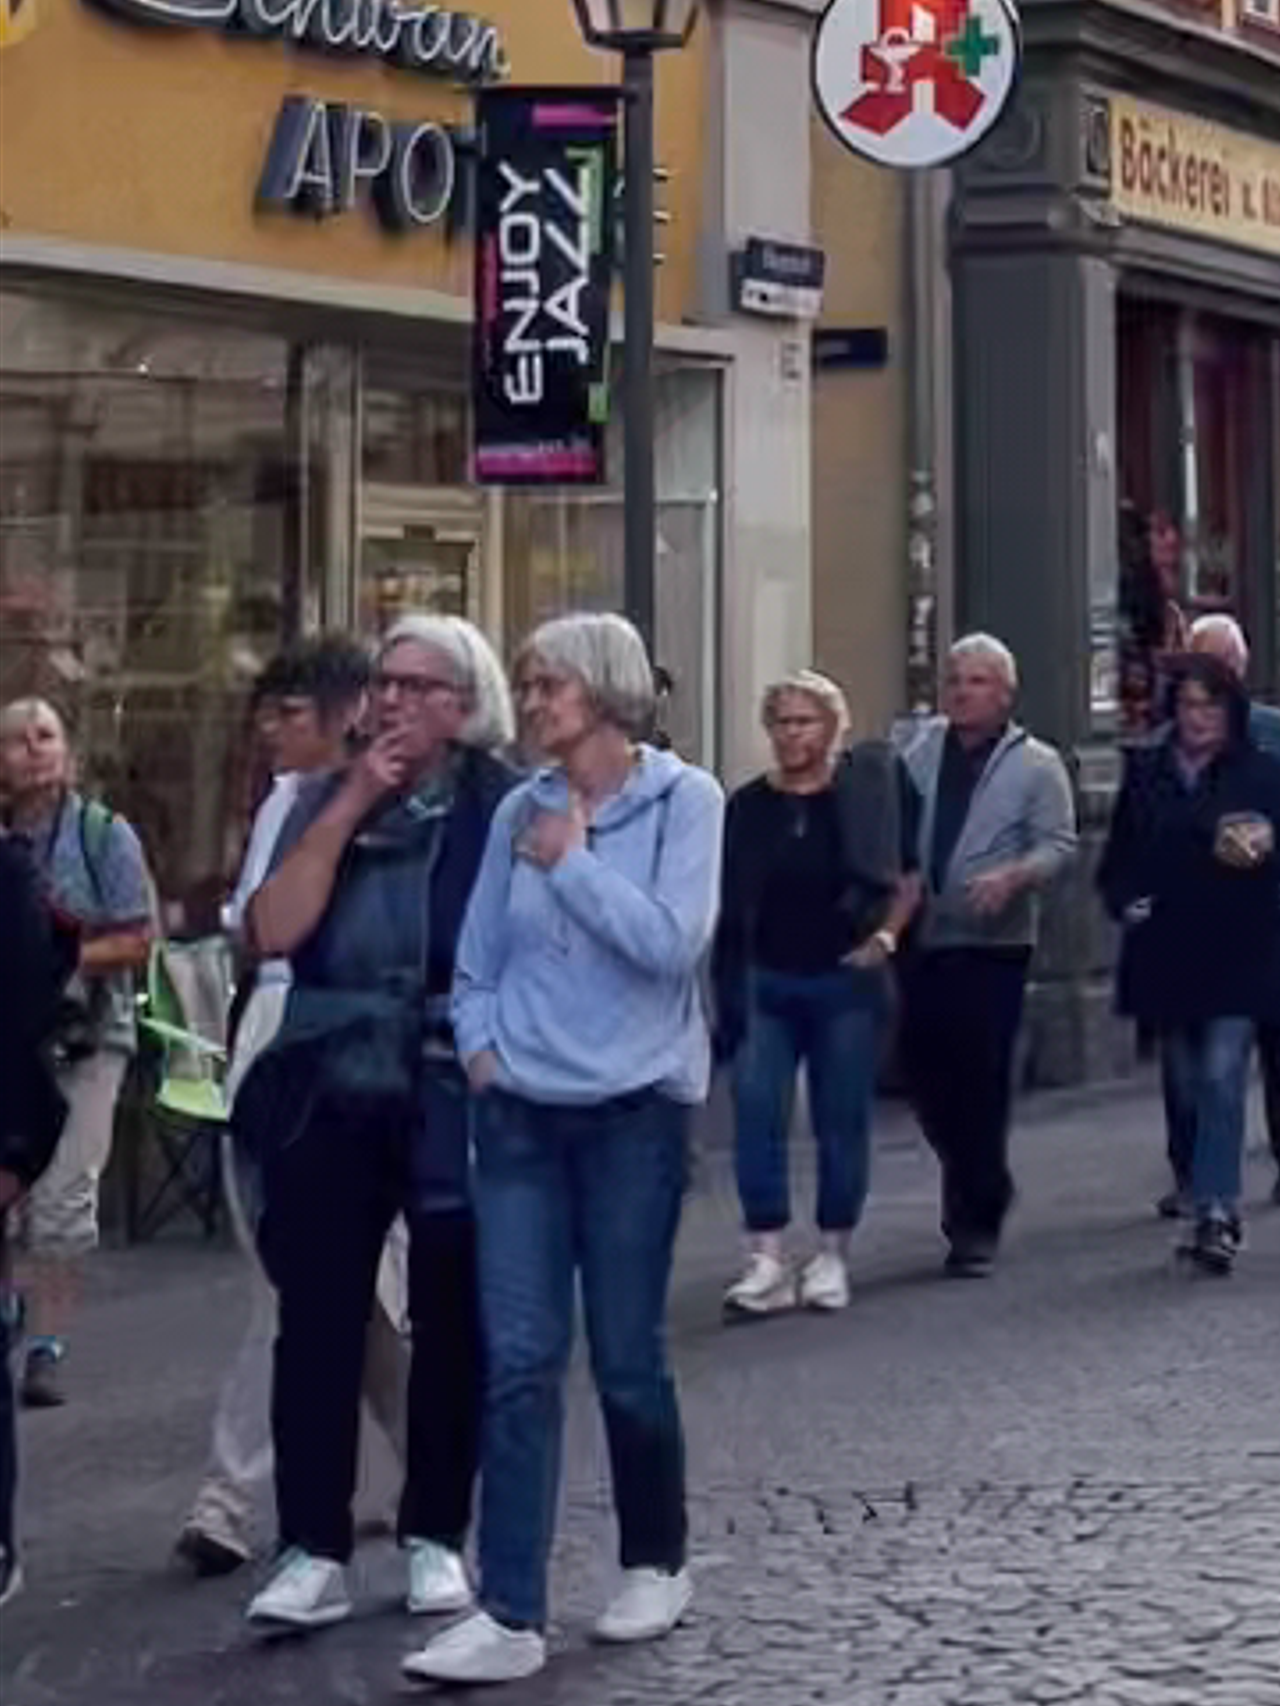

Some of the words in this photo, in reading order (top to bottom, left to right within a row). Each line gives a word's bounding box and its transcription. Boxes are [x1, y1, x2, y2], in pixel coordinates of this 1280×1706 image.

[1119, 117, 1230, 218] Bäckerei
[500, 160, 544, 404] ENJOY
[544, 168, 590, 364] JAZZ
